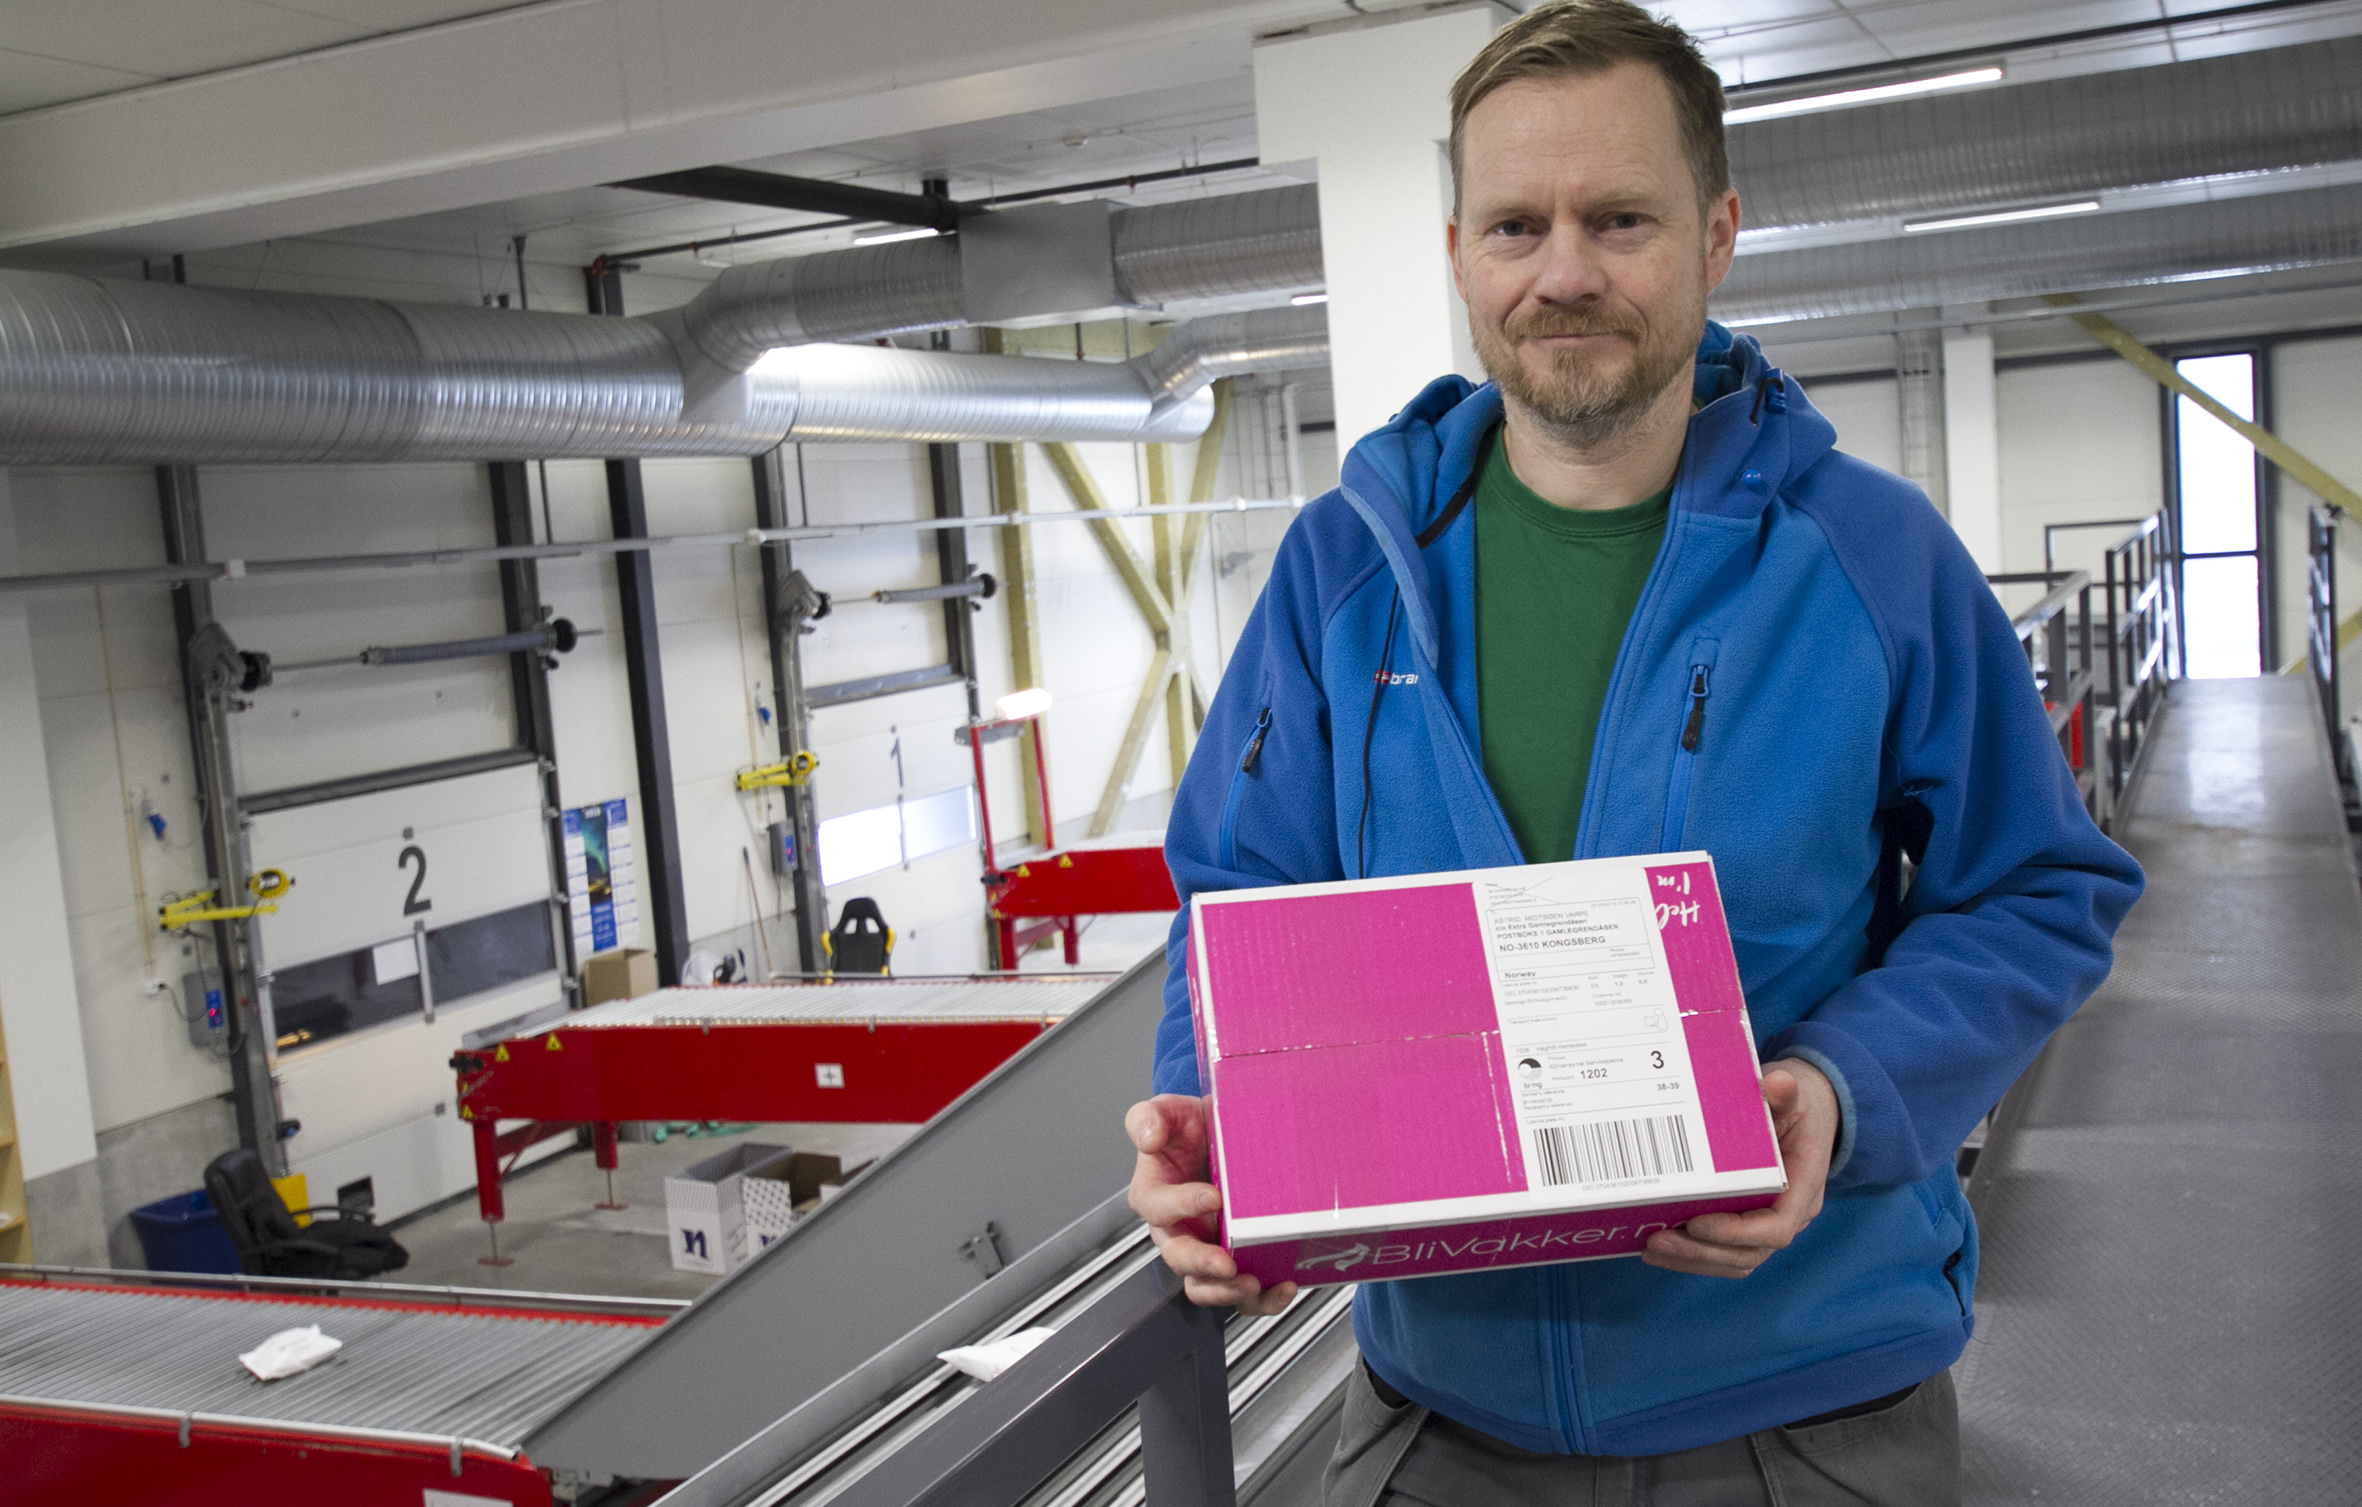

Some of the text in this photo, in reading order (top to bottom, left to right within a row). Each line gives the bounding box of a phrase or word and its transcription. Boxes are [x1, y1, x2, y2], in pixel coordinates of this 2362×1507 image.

[1389, 673, 1418, 684] bra
[890, 738, 904, 788] 1
[399, 846, 431, 915] 2
[1656, 871, 1690, 895] I'm
[1494, 915, 1521, 925] ASTRID
[1508, 922, 1528, 931] Extra
[1496, 930, 1538, 940] POSTBOKS
[1499, 936, 1606, 952] NO-3610 KONGSBERG
[1504, 971, 1536, 979] Norway
[1650, 1050, 1665, 1069] 3
[1580, 1068, 1609, 1080] 1202
[1523, 1081, 1543, 1090] bring
[1656, 1082, 1680, 1092] 38-39
[1373, 1220, 1688, 1265] BliVakker.n
